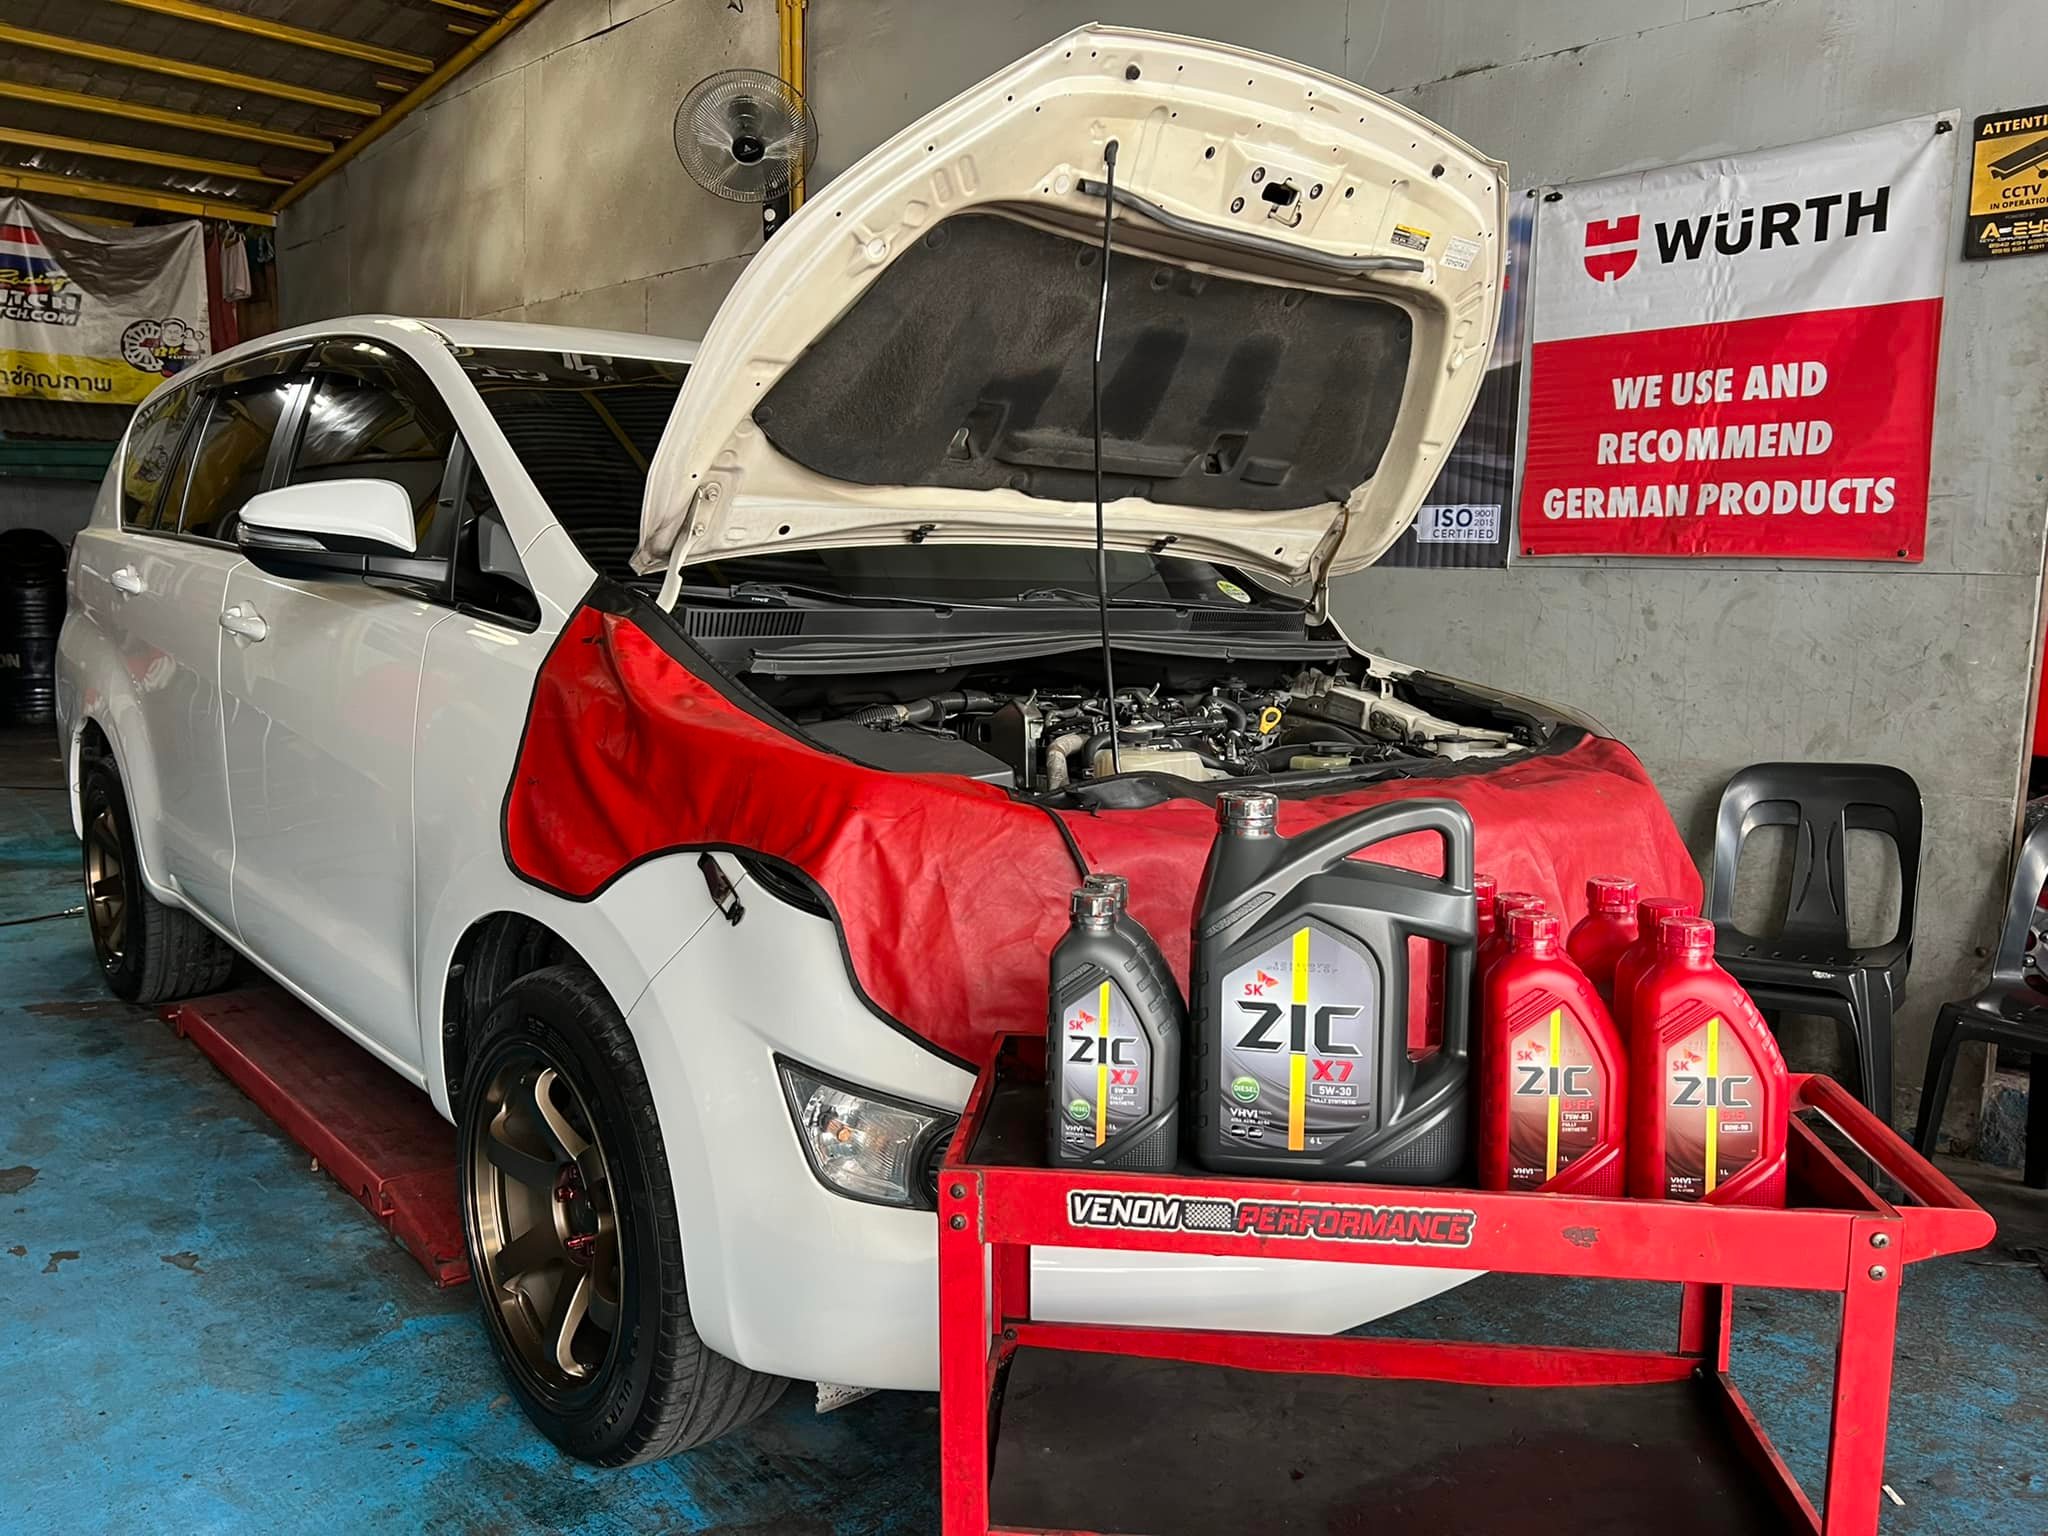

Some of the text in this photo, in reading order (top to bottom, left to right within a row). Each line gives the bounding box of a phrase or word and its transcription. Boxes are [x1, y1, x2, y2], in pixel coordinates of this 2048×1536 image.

[2002, 184, 2042, 199] CCTV
[2002, 196, 2048, 209] OPERATIO
[1654, 186, 1890, 264] WÜRTH
[1612, 361, 1828, 410] WE USE AND
[1597, 420, 1833, 465] RECOMMEND
[1543, 477, 1896, 520] GERMAN PRODUCTS
[1434, 508, 1495, 527] ISO 9001
[1433, 529, 1495, 539] CERTIFIED
[1244, 983, 1264, 996] SK
[1068, 1020, 1084, 1030] SK
[1234, 1000, 1364, 1056] ZIC
[1067, 1034, 1138, 1066] ZIC
[1517, 1050, 1533, 1061] SK
[1312, 1059, 1354, 1082] X7
[1673, 1061, 1689, 1071] SK
[1111, 1068, 1139, 1086] X7
[1515, 1066, 1593, 1096] ZIC
[1233, 1084, 1258, 1094] DIESEL
[1318, 1087, 1352, 1096] 5W-30
[1672, 1076, 1752, 1107] ZIC
[1072, 1196, 1475, 1242] VENOM PERFORMANCE
